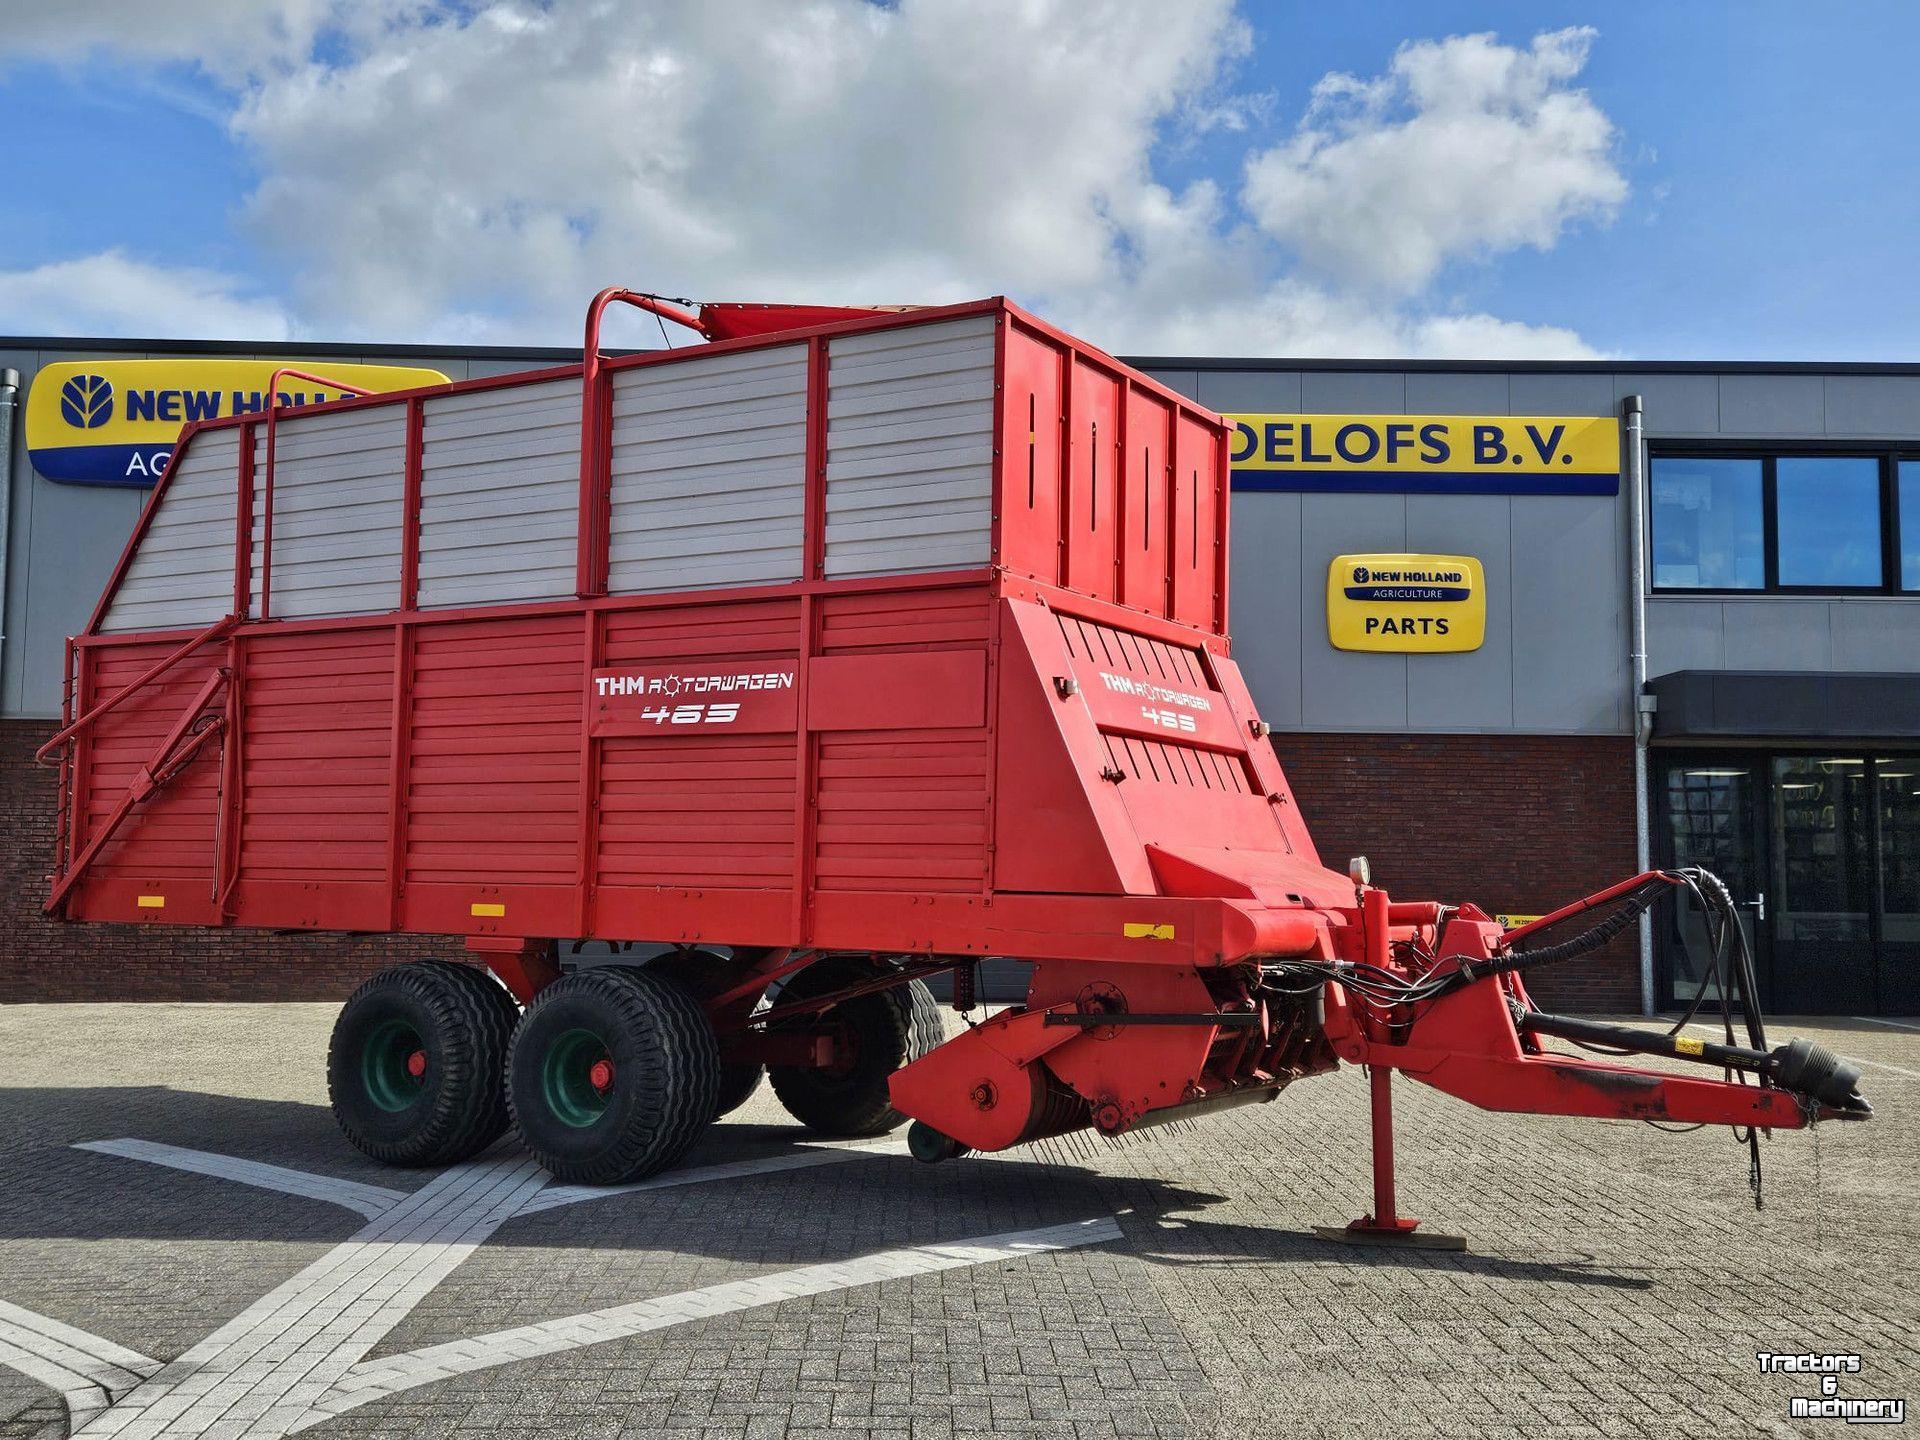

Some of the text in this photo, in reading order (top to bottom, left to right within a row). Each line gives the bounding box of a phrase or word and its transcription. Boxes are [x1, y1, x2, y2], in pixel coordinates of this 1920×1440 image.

[126, 389, 221, 421] NEW
[1474, 425, 1573, 465] B.V.
[1372, 572, 1462, 582] NEW HOLLAND
[1373, 590, 1442, 598] AGRICULTURE
[1365, 617, 1449, 635] PARTS
[595, 672, 794, 698] THM ROTORWAGEN
[1099, 671, 1211, 711] THM ROTORWAGEN
[640, 703, 741, 725] 465
[1141, 706, 1196, 732] 465
